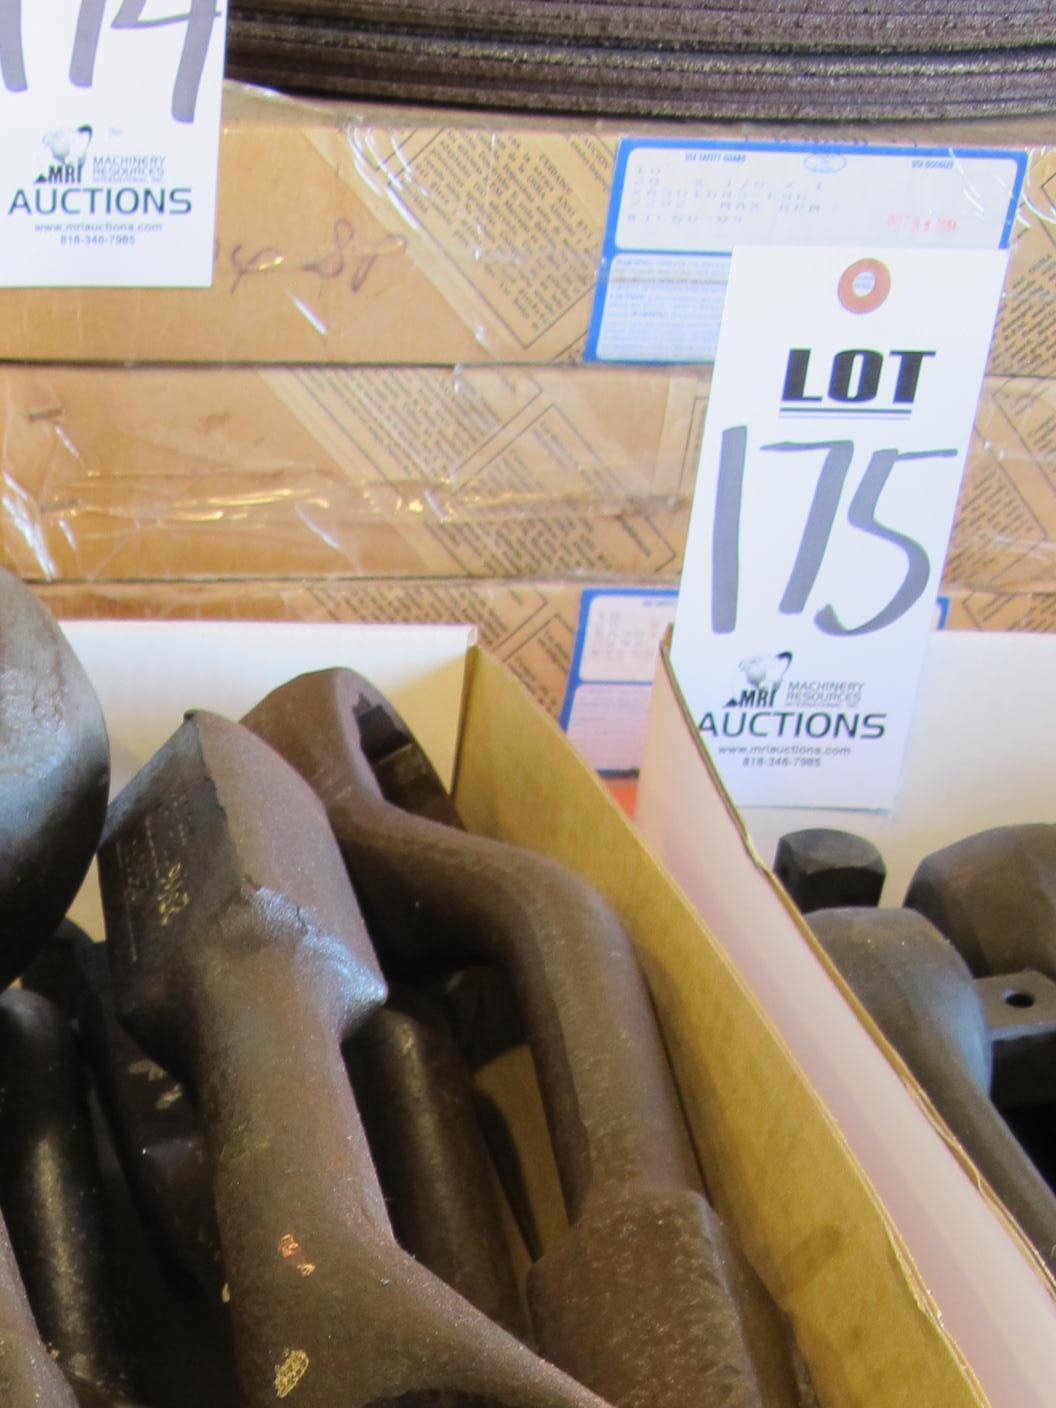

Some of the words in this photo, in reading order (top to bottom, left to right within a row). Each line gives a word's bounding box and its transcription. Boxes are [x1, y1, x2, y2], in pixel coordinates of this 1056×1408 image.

[47, 163, 84, 184] MRI
[8, 186, 192, 215] AUCTIONS
[781, 348, 936, 404] LOT
[711, 425, 958, 637] 175
[739, 686, 780, 708] MRI
[698, 711, 887, 739] AUCTIONS
